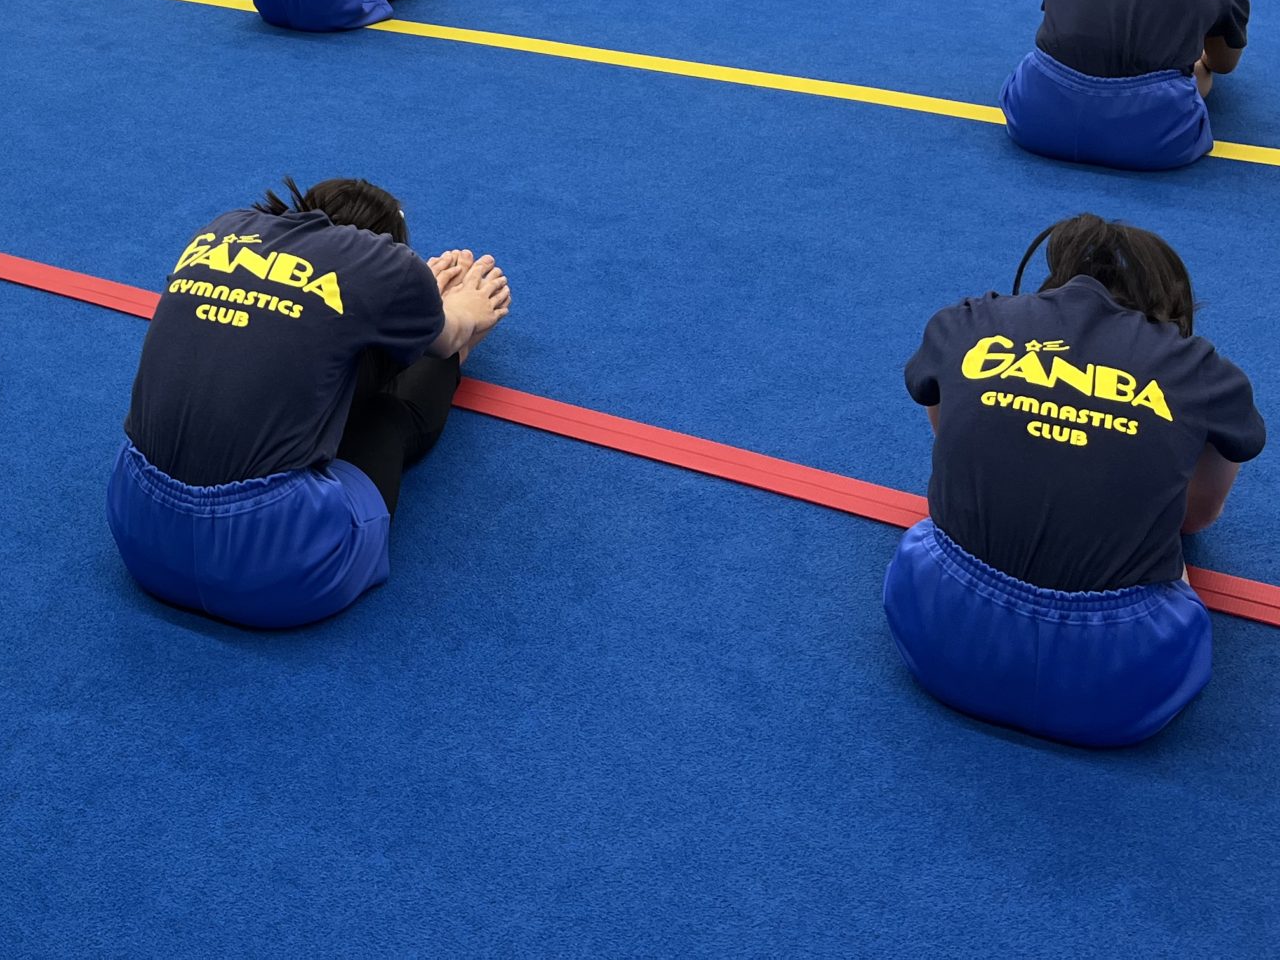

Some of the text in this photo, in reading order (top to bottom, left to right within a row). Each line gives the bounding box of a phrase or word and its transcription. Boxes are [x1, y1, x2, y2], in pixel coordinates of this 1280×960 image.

[173, 232, 344, 315] GANBA
[169, 278, 304, 319] GYMNASTICS
[195, 305, 250, 328] CLUB
[961, 335, 1174, 422] GANBA
[980, 391, 1140, 435] GYMNASTICS
[1026, 420, 1089, 447] CLUB
